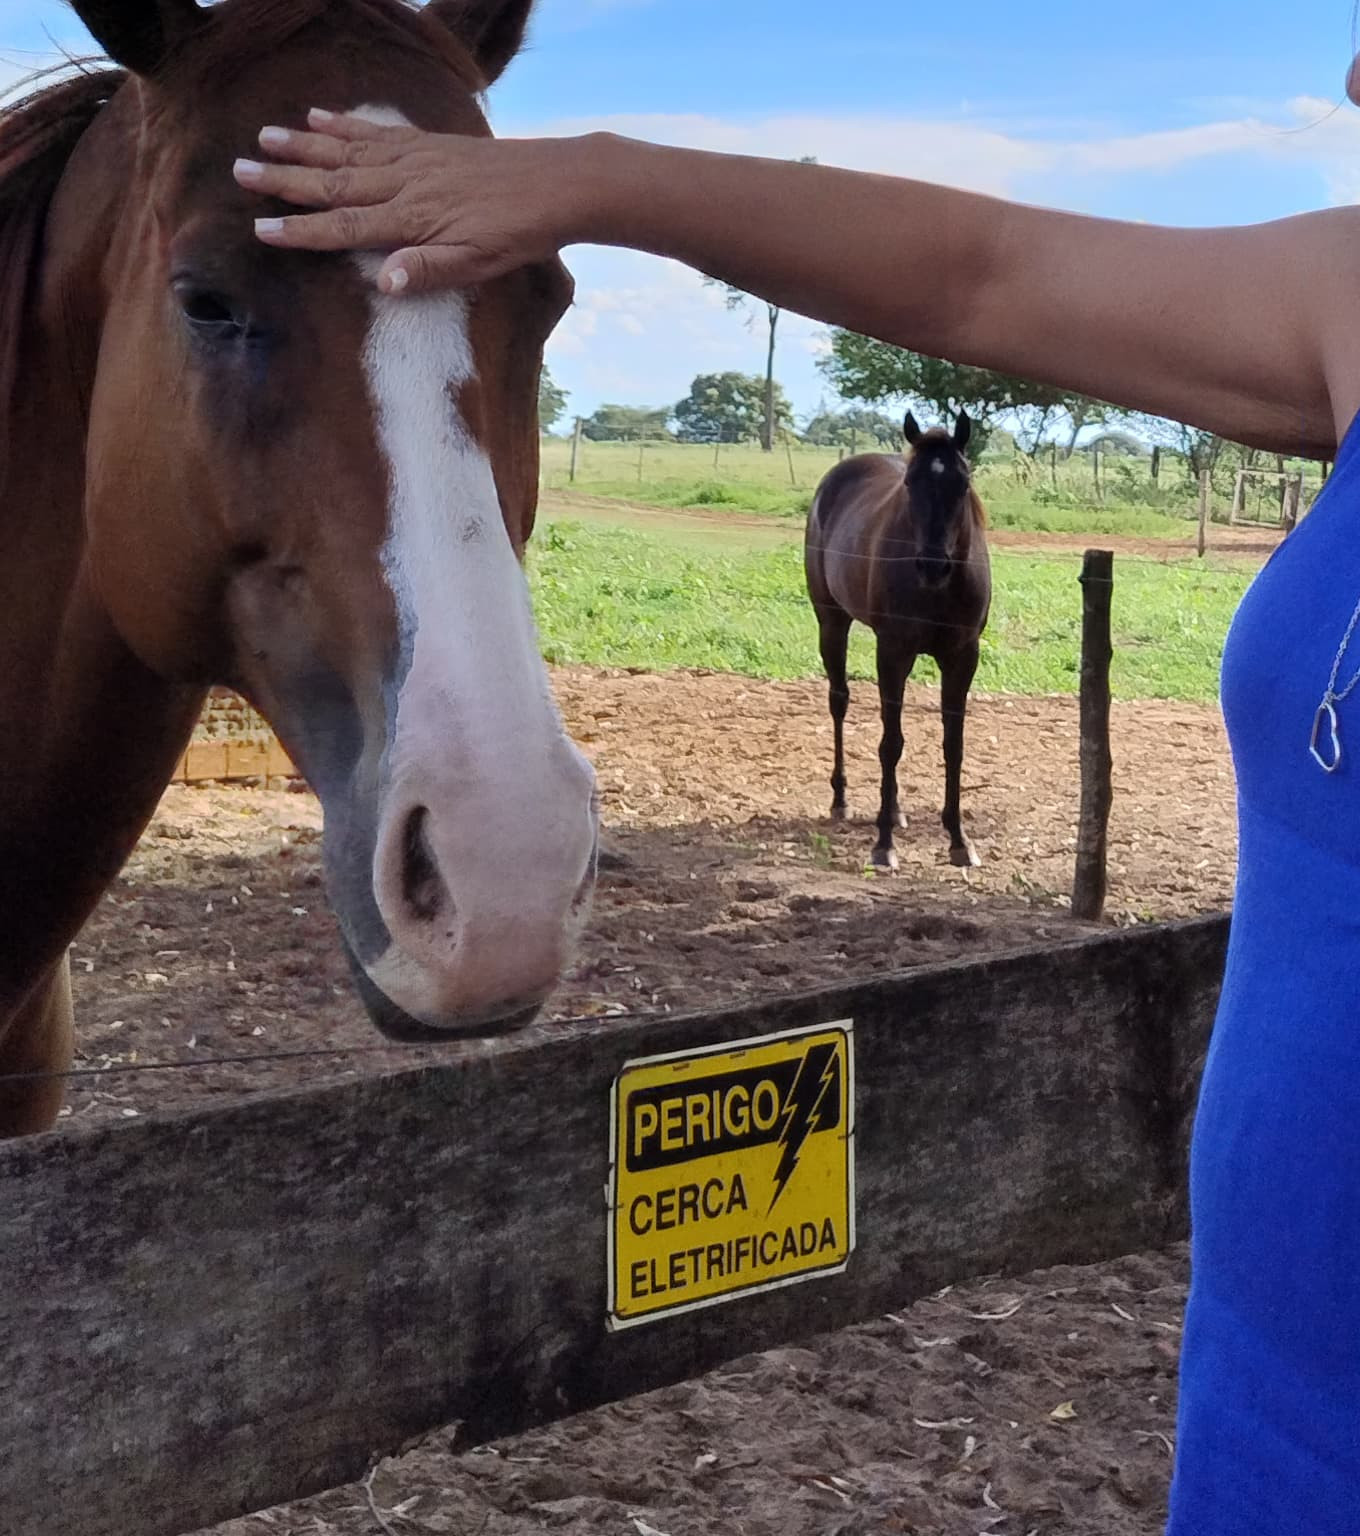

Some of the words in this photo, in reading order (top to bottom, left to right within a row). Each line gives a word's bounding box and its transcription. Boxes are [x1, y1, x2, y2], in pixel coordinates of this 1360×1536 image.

[634, 1079, 780, 1156] PERIGO
[629, 1174, 748, 1236] CERCA
[630, 1217, 837, 1299] ELETRIFICADA
